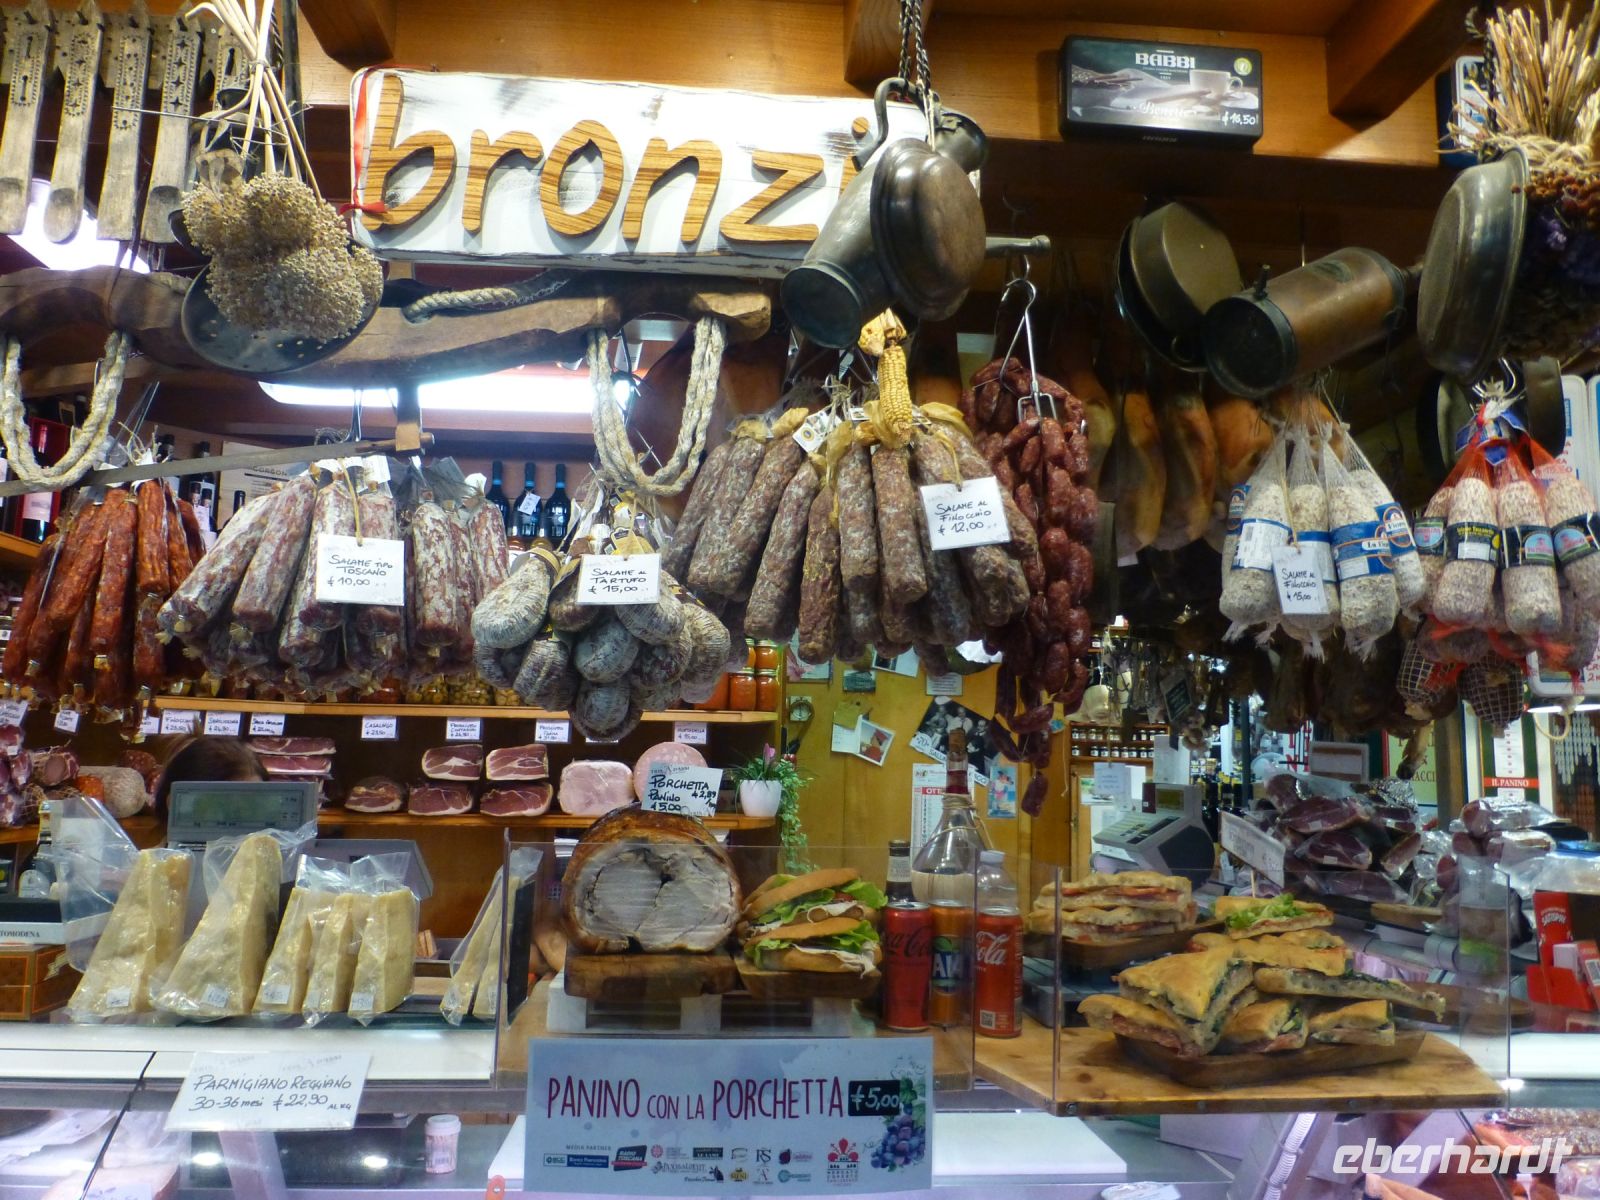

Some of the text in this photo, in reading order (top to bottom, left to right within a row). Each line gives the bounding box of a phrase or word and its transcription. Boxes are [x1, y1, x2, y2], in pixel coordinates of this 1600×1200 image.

[1135, 52, 1196, 69] BABBI
[935, 501, 974, 516] SALAME
[951, 522, 984, 533] 12,00
[328, 554, 372, 567] SALAME
[336, 565, 387, 576] TOSCANO
[592, 568, 635, 577] SALAME
[337, 577, 370, 587] 10,00
[590, 576, 647, 584] TARTUFO
[602, 585, 638, 593] 15,00
[648, 774, 710, 790] PORCHETTA
[1491, 778, 1529, 787] IL PANINO
[648, 788, 681, 802] PANINO
[193, 1073, 288, 1092] PARMIGIANO
[188, 1096, 239, 1112] 30-36
[284, 1094, 329, 1107] 22,90
[547, 1075, 844, 1121] PANINO CON LA PORCHETTA
[865, 1086, 900, 1111] 5,00
